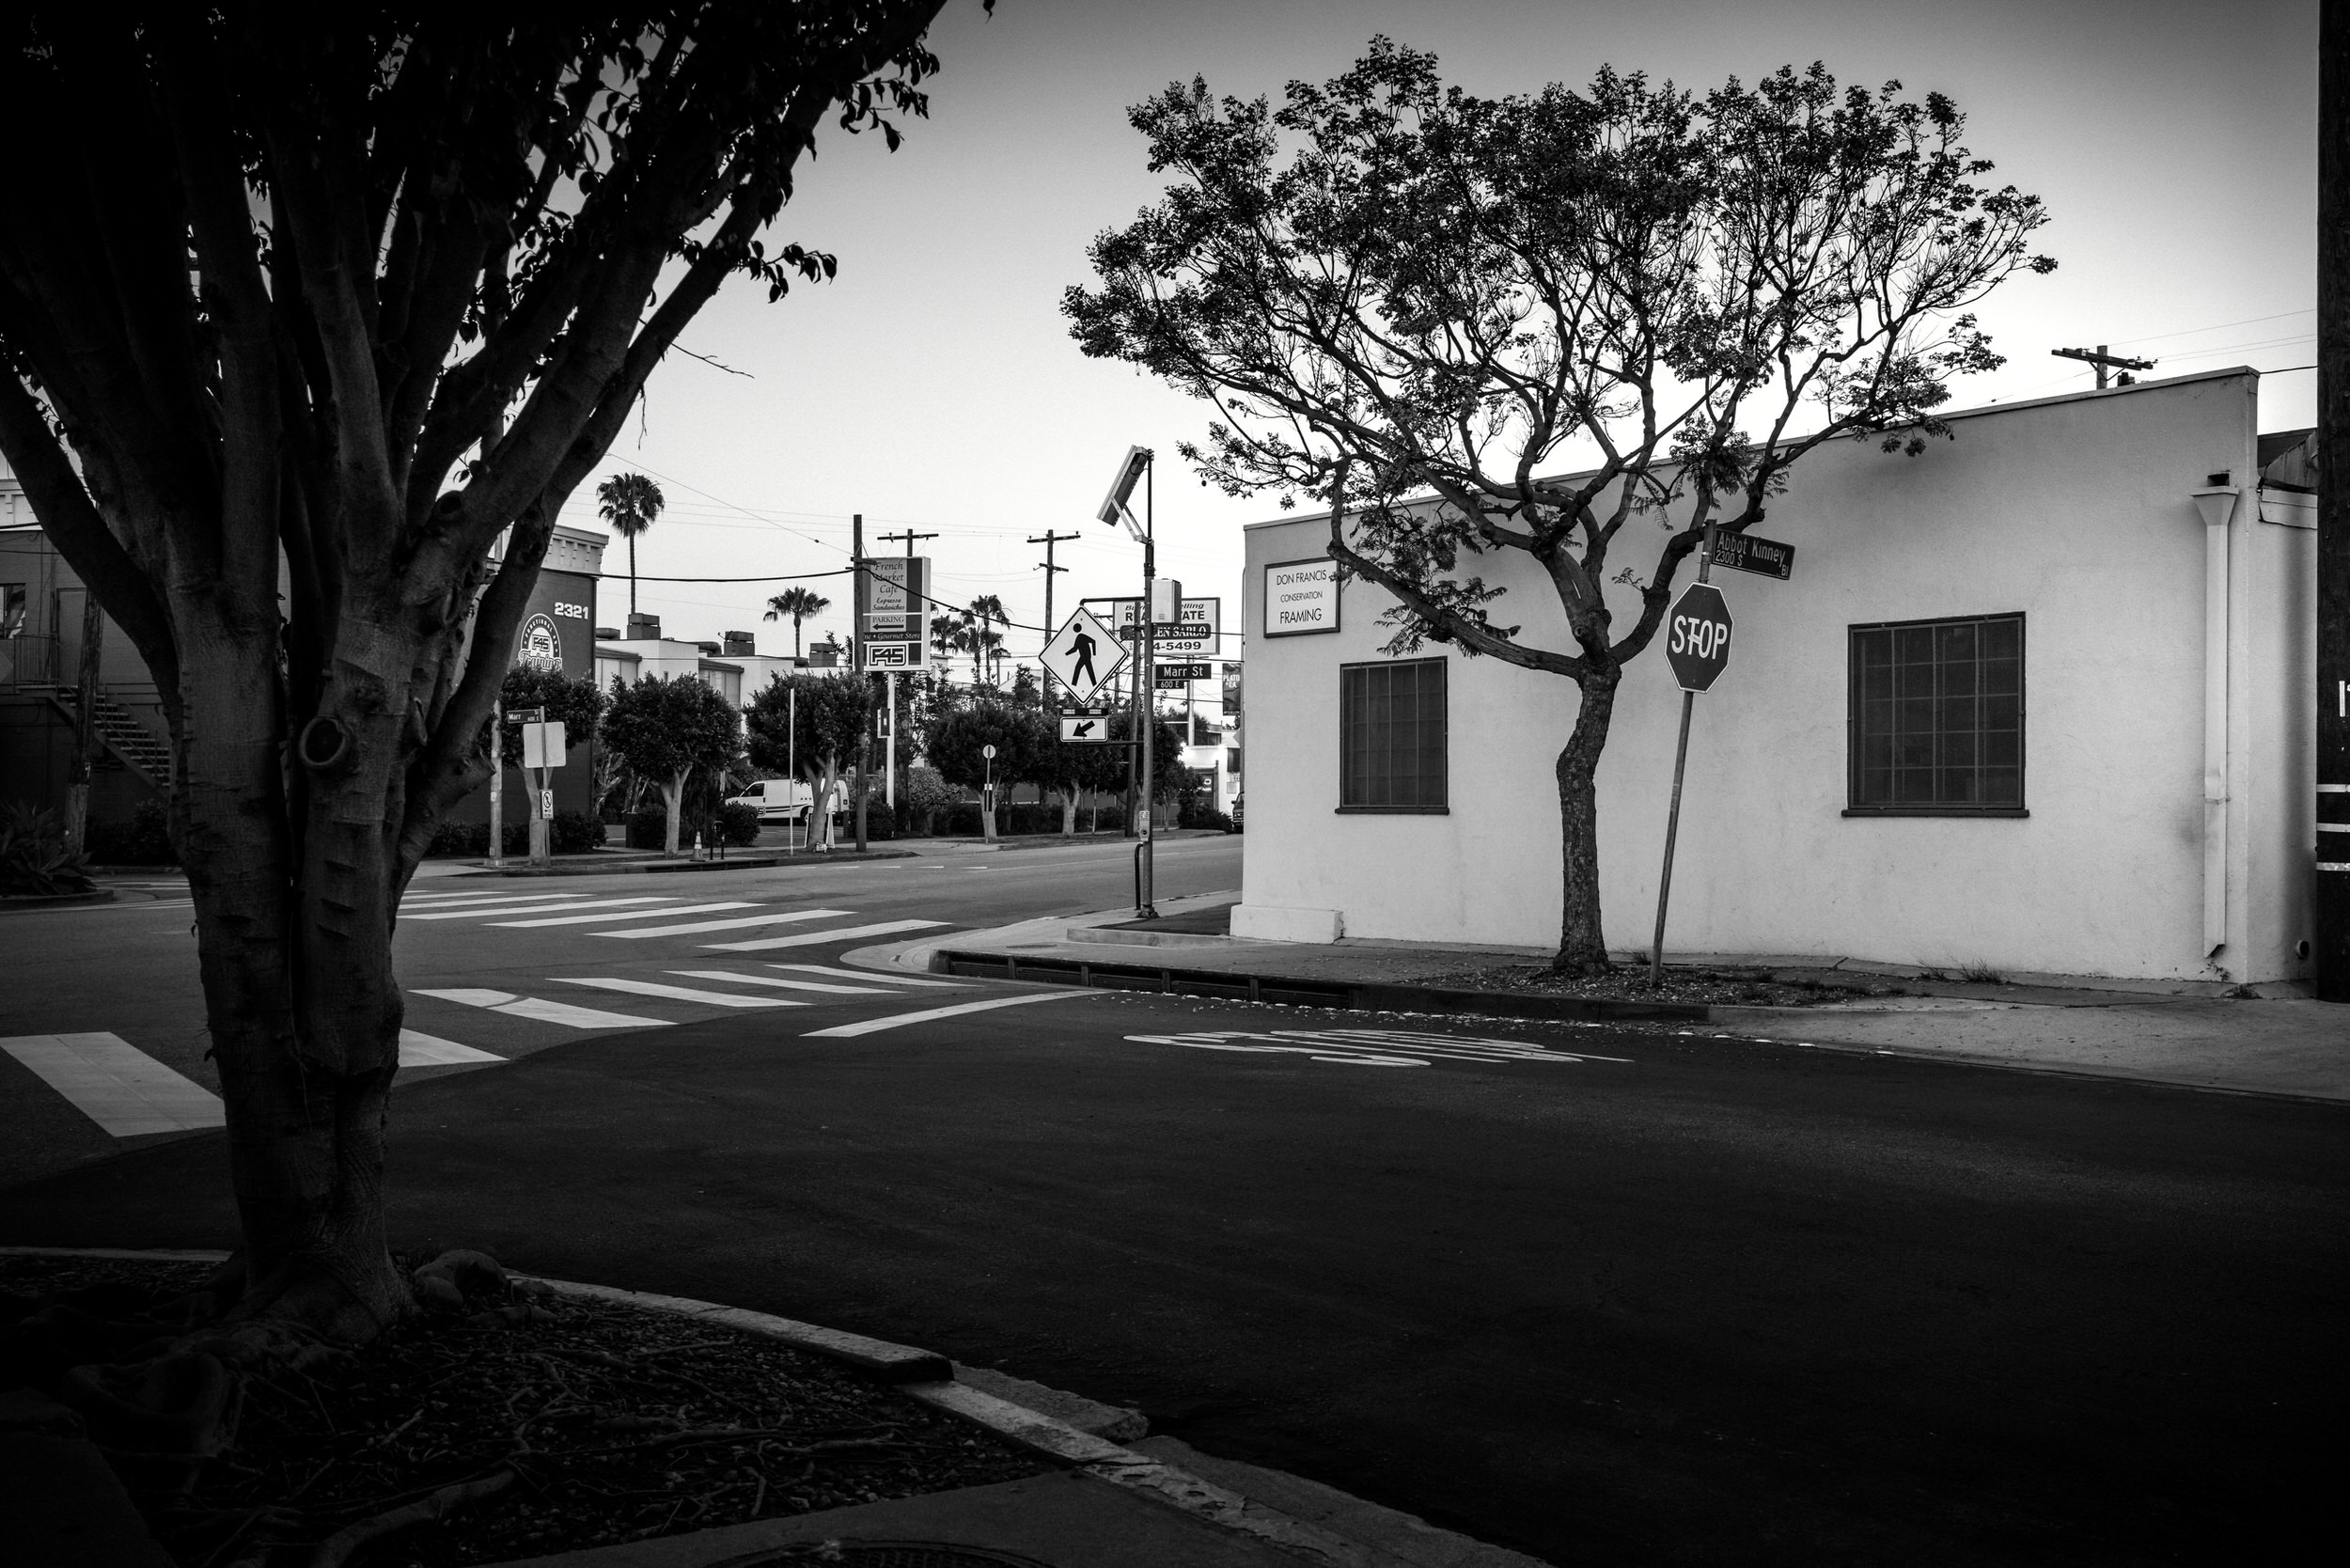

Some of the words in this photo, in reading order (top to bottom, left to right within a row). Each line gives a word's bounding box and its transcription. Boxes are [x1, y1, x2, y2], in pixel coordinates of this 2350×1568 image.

[1715, 550, 1735, 565] 2300
[1737, 555, 1743, 567] S
[1716, 532, 1748, 556] Abbot
[1751, 540, 1786, 568] Kinney
[874, 557, 903, 571] French
[1277, 573, 1294, 586] DON
[1295, 570, 1326, 584] FRANCIS
[1279, 590, 1323, 603] CONSERVATION
[554, 602, 589, 620] 2321
[1279, 607, 1323, 624] FRAMING
[1172, 626, 1207, 637] SARLO
[1670, 614, 1729, 660] STOP
[870, 645, 906, 666] F45
[1163, 666, 1187, 677] Marr
[1192, 666, 1203, 677] St
[509, 713, 522, 721] Marr
[1123, 1028, 1634, 1067] STOP
